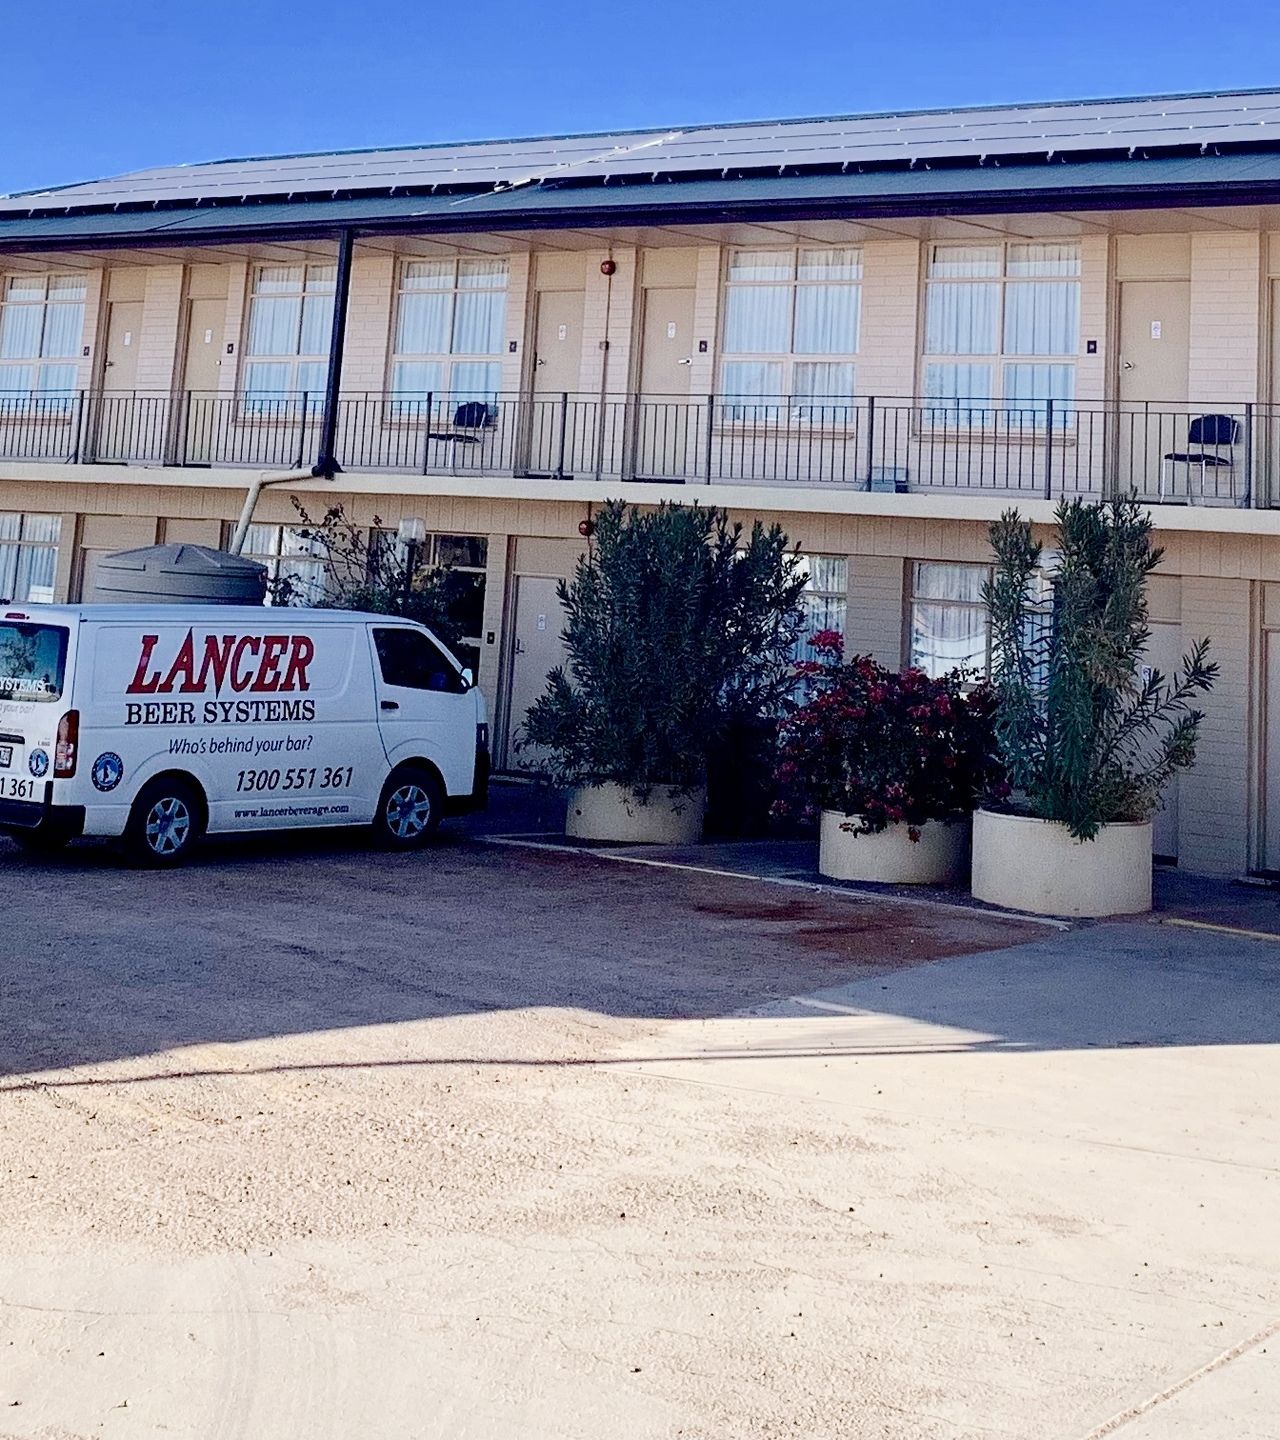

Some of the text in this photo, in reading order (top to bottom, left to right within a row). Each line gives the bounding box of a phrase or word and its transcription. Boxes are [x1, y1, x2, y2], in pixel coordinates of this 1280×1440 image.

[125, 626, 315, 699] LANCER
[124, 699, 316, 725] BEER SYSTEMS
[169, 735, 313, 756] Who's behind your bar?
[9, 778, 34, 798] 361
[236, 766, 353, 792] 1300 551 361
[234, 804, 350, 819] www.lancerbeverage.com
